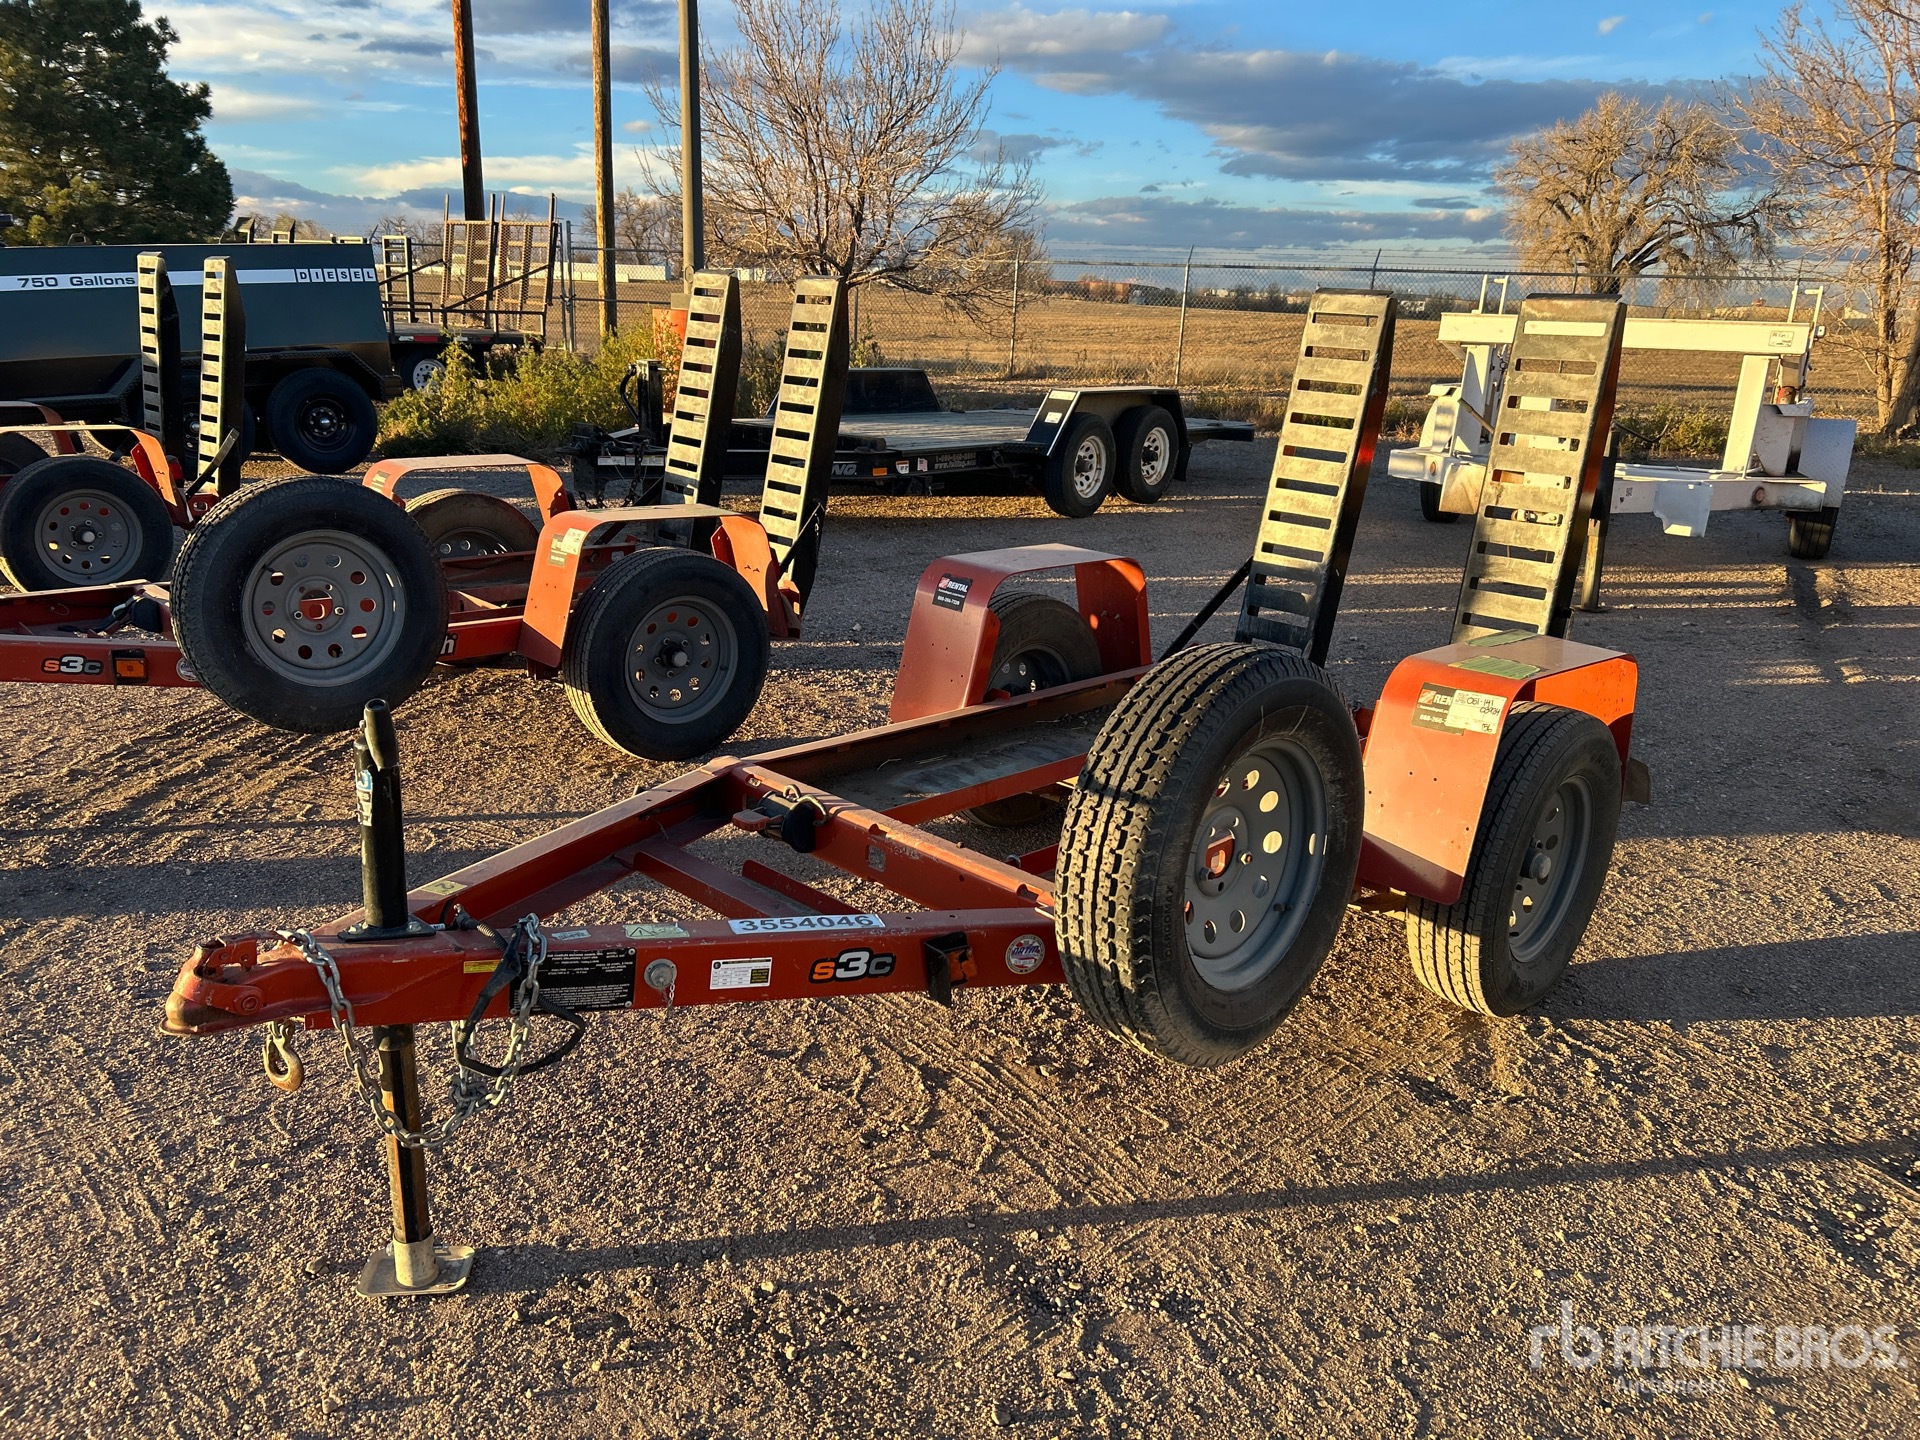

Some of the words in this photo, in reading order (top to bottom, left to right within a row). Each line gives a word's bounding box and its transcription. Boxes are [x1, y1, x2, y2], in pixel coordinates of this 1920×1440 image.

[299, 271, 374, 280] DIESEL
[17, 277, 58, 288] 750
[70, 276, 136, 287] Gallons
[946, 580, 969, 593] RENTAL
[739, 914, 875, 931] 3554046
